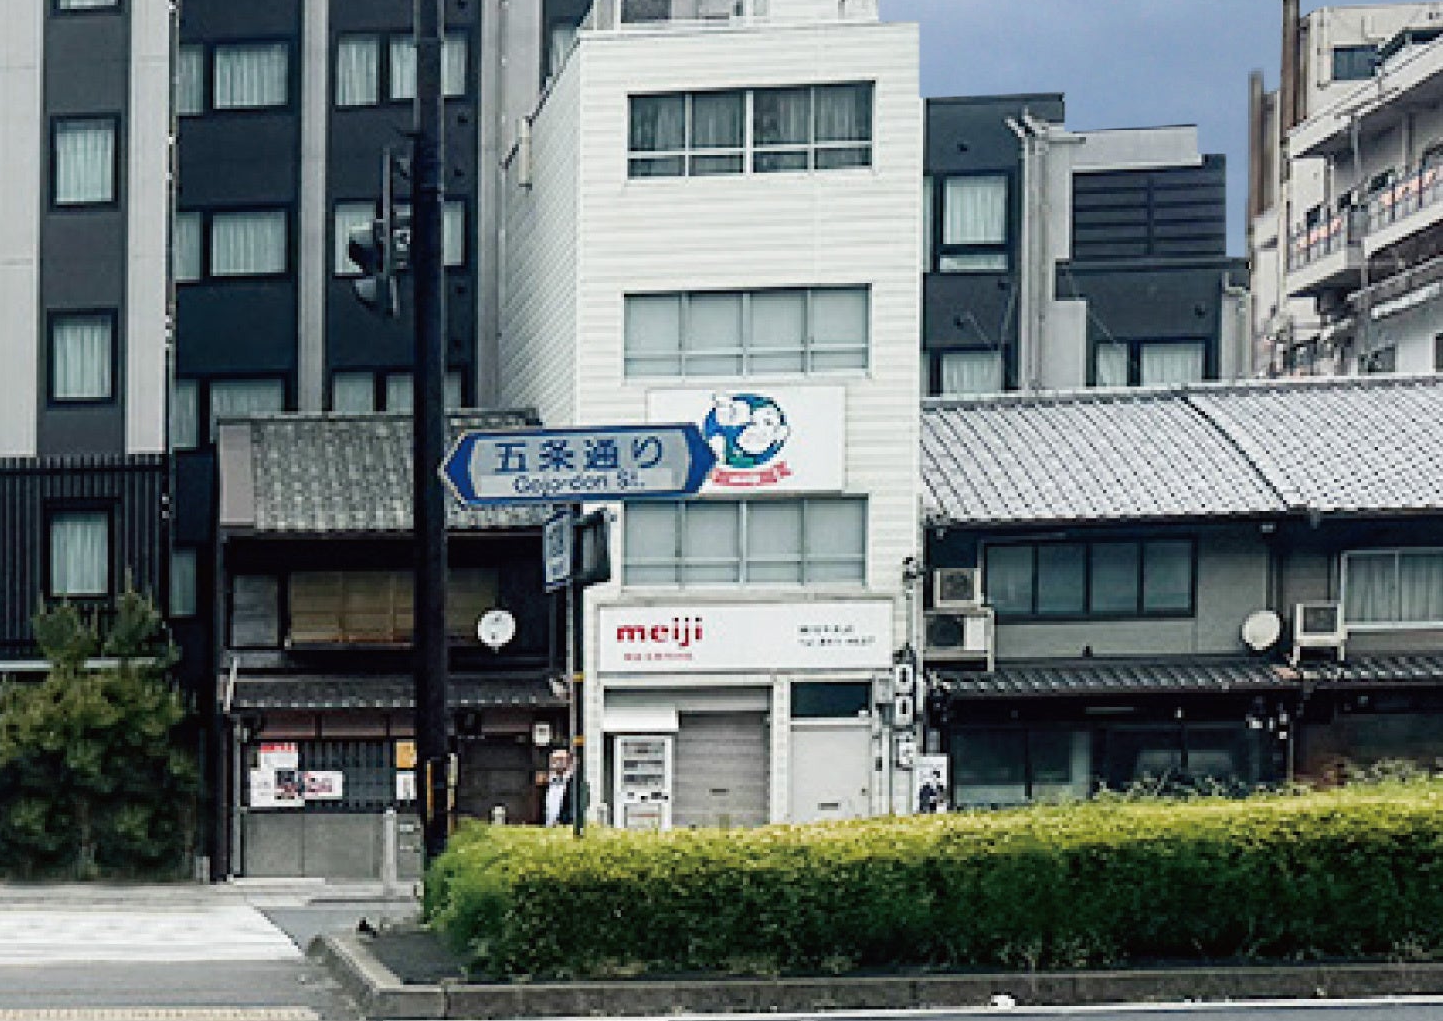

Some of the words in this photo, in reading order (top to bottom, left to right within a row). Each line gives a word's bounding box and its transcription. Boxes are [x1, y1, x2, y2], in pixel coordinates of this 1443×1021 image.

[494, 435, 663, 473] 五条通り
[616, 617, 703, 648] meiji
